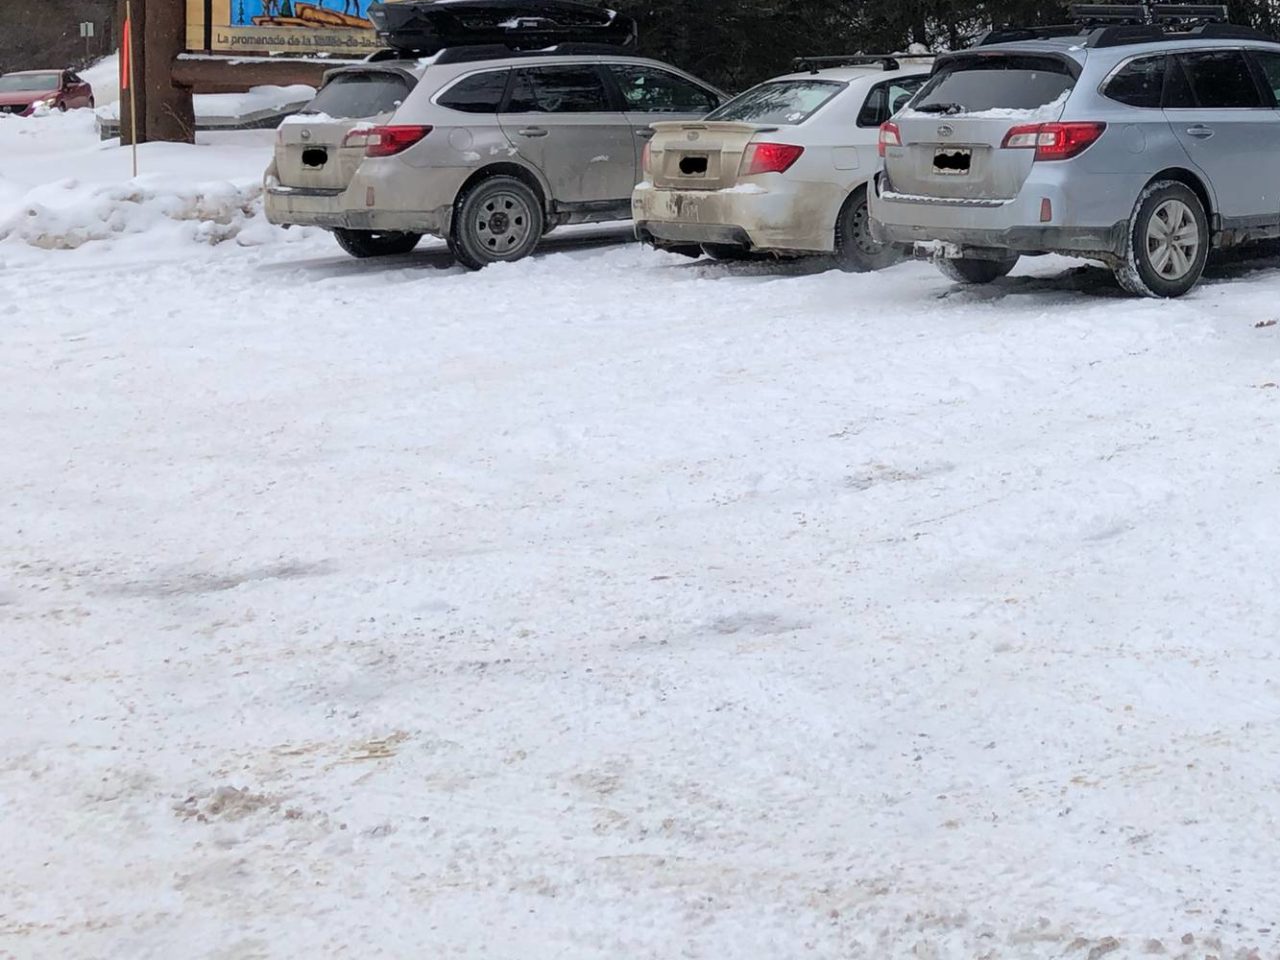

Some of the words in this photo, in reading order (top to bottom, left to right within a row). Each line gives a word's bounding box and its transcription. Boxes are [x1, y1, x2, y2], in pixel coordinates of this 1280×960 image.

[217, 34, 229, 44] La
[231, 35, 285, 46] promenade
[287, 35, 300, 45] de
[302, 35, 312, 45] la
